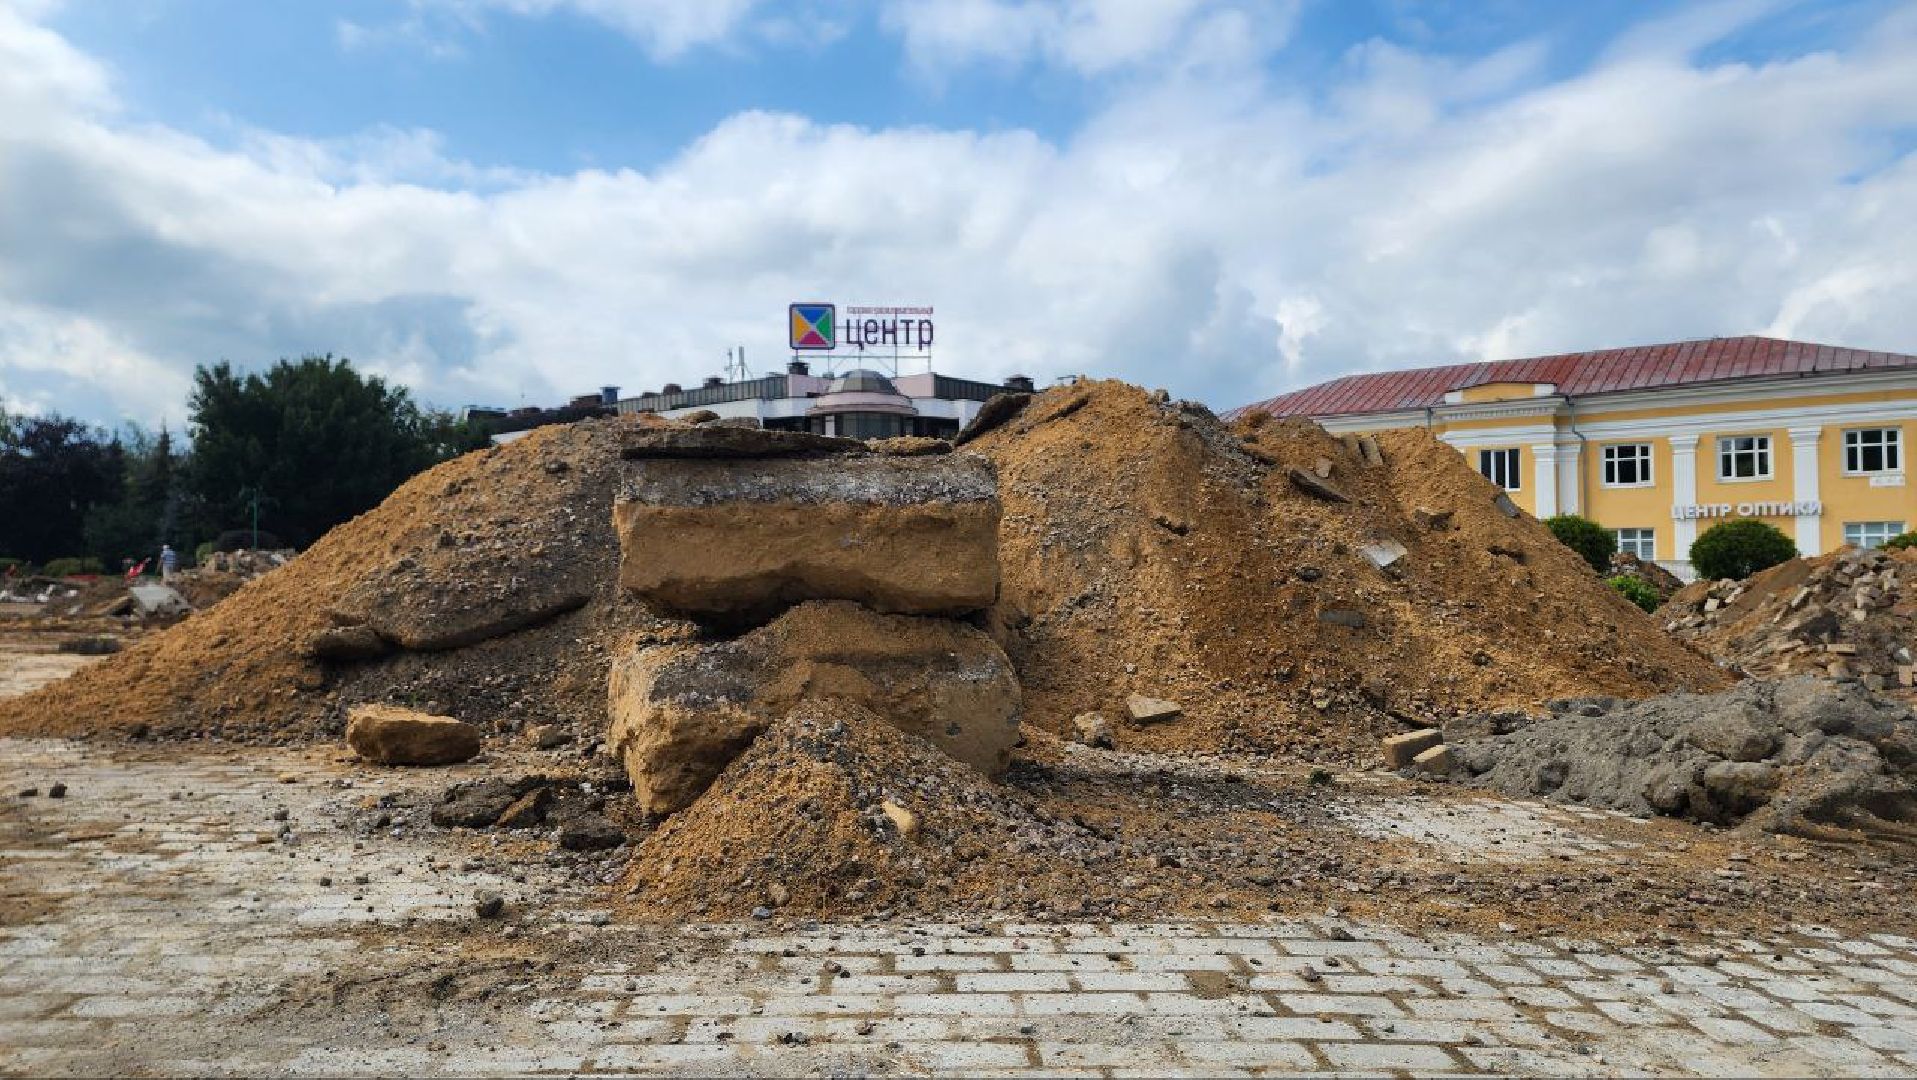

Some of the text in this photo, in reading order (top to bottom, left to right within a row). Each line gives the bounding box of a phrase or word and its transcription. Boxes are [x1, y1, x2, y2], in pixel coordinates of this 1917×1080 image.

[846, 319, 933, 351] центр
[1672, 501, 1822, 520] ЦЕНТР ОПТИКИ
